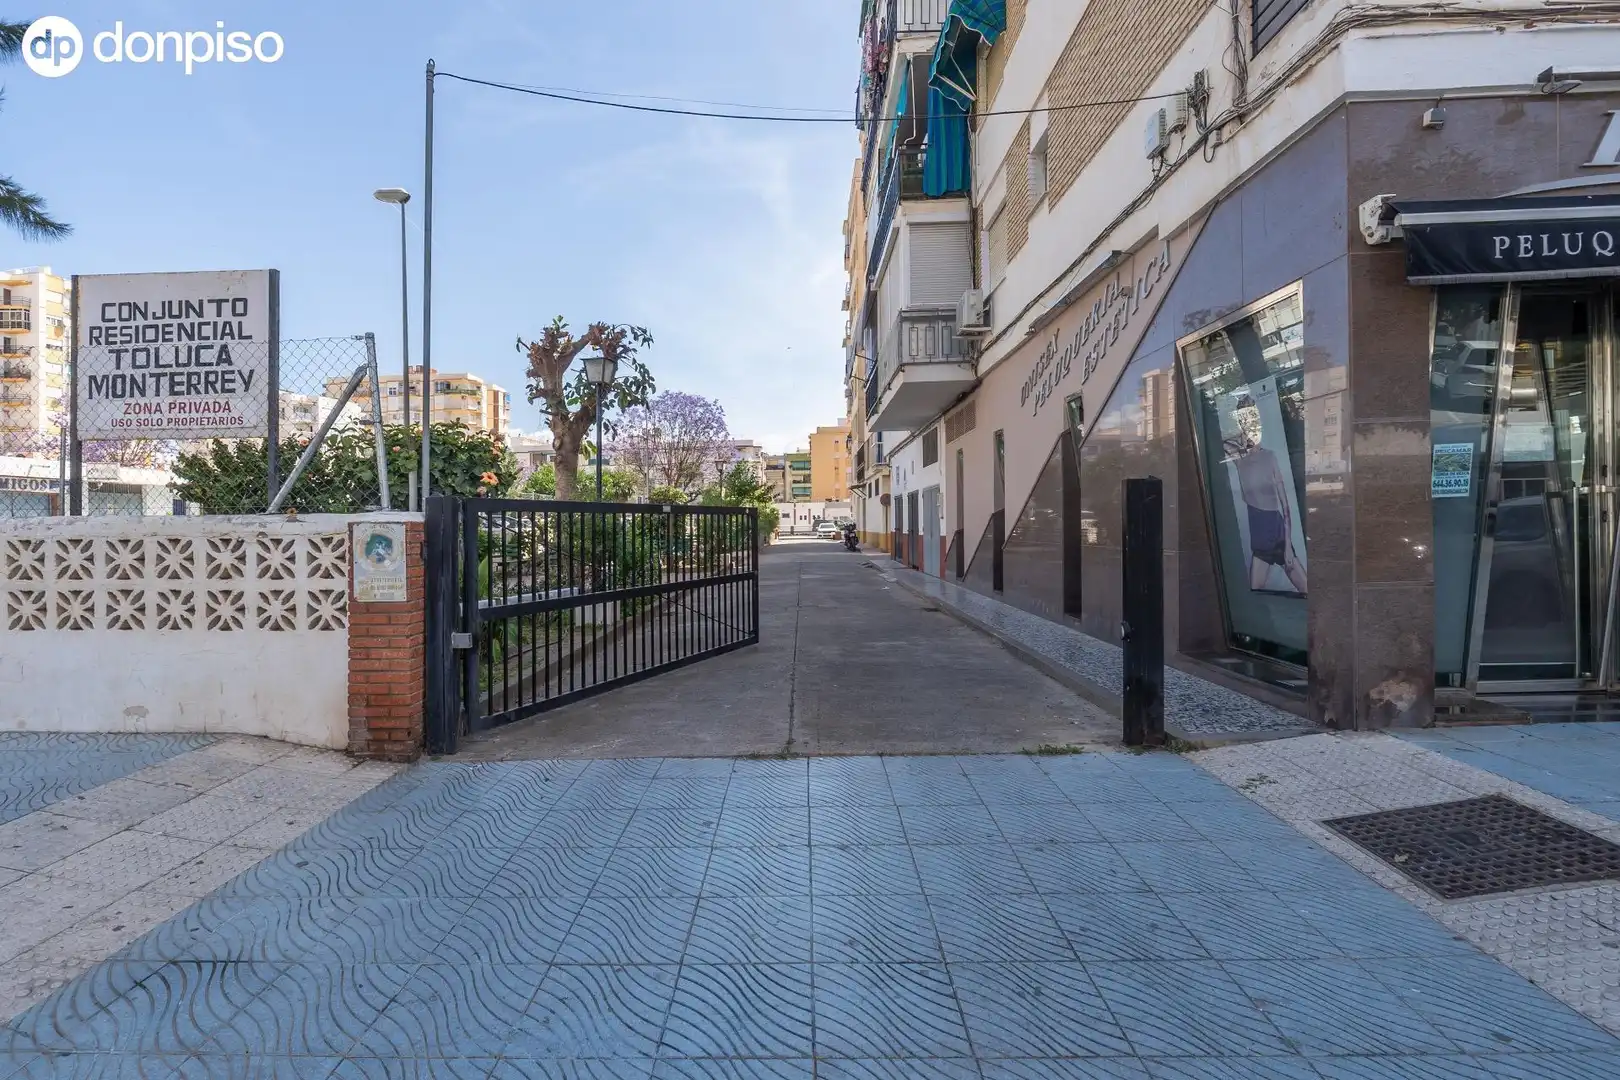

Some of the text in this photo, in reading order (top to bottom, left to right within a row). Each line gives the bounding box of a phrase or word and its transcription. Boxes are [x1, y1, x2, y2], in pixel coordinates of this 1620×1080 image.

[1492, 230, 1615, 259] PELUQ
[101, 297, 248, 323] CONJUNTO
[89, 320, 253, 345] RESIDENCIAL
[108, 344, 233, 370] TOLUCA
[88, 369, 255, 399] MONTERREY
[123, 400, 232, 415] ZONA PRIVADA
[111, 415, 244, 428] USO SOLO PROPIETARIOS
